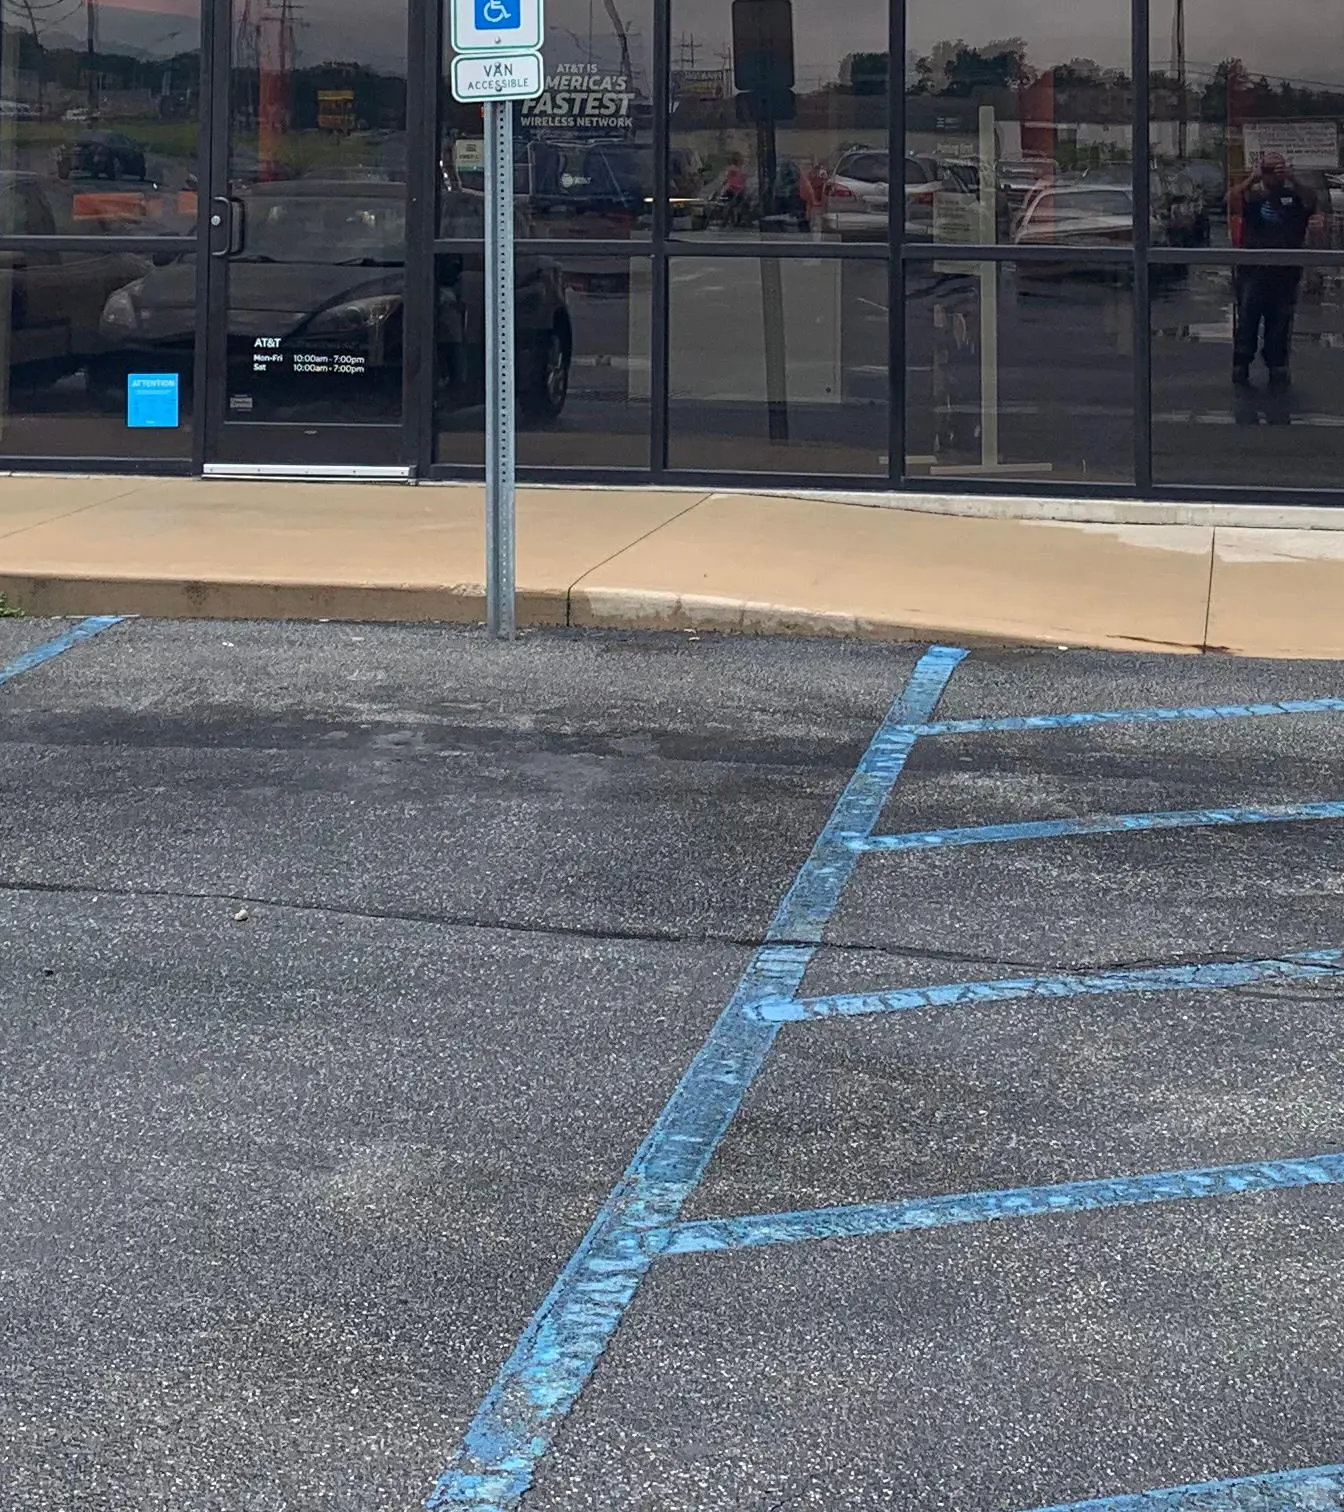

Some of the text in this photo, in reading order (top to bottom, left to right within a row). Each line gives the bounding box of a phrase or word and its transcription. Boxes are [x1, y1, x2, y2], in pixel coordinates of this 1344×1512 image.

[483, 63, 513, 77] VAN
[557, 63, 598, 73] AT&T IS
[468, 77, 529, 90] ACCESSIBLE
[544, 75, 628, 91] MERICA'S
[521, 92, 635, 116] FASTEST
[521, 116, 633, 128] WIRELESS NETWORK
[253, 337, 281, 348] AT&T
[253, 354, 283, 363] Mon-Fri
[293, 354, 328, 363] 10:00am
[333, 355, 365, 365] 7:00pm
[253, 363, 267, 372] Sat
[293, 363, 328, 373] 10:00am
[333, 364, 365, 375] 7:00pm
